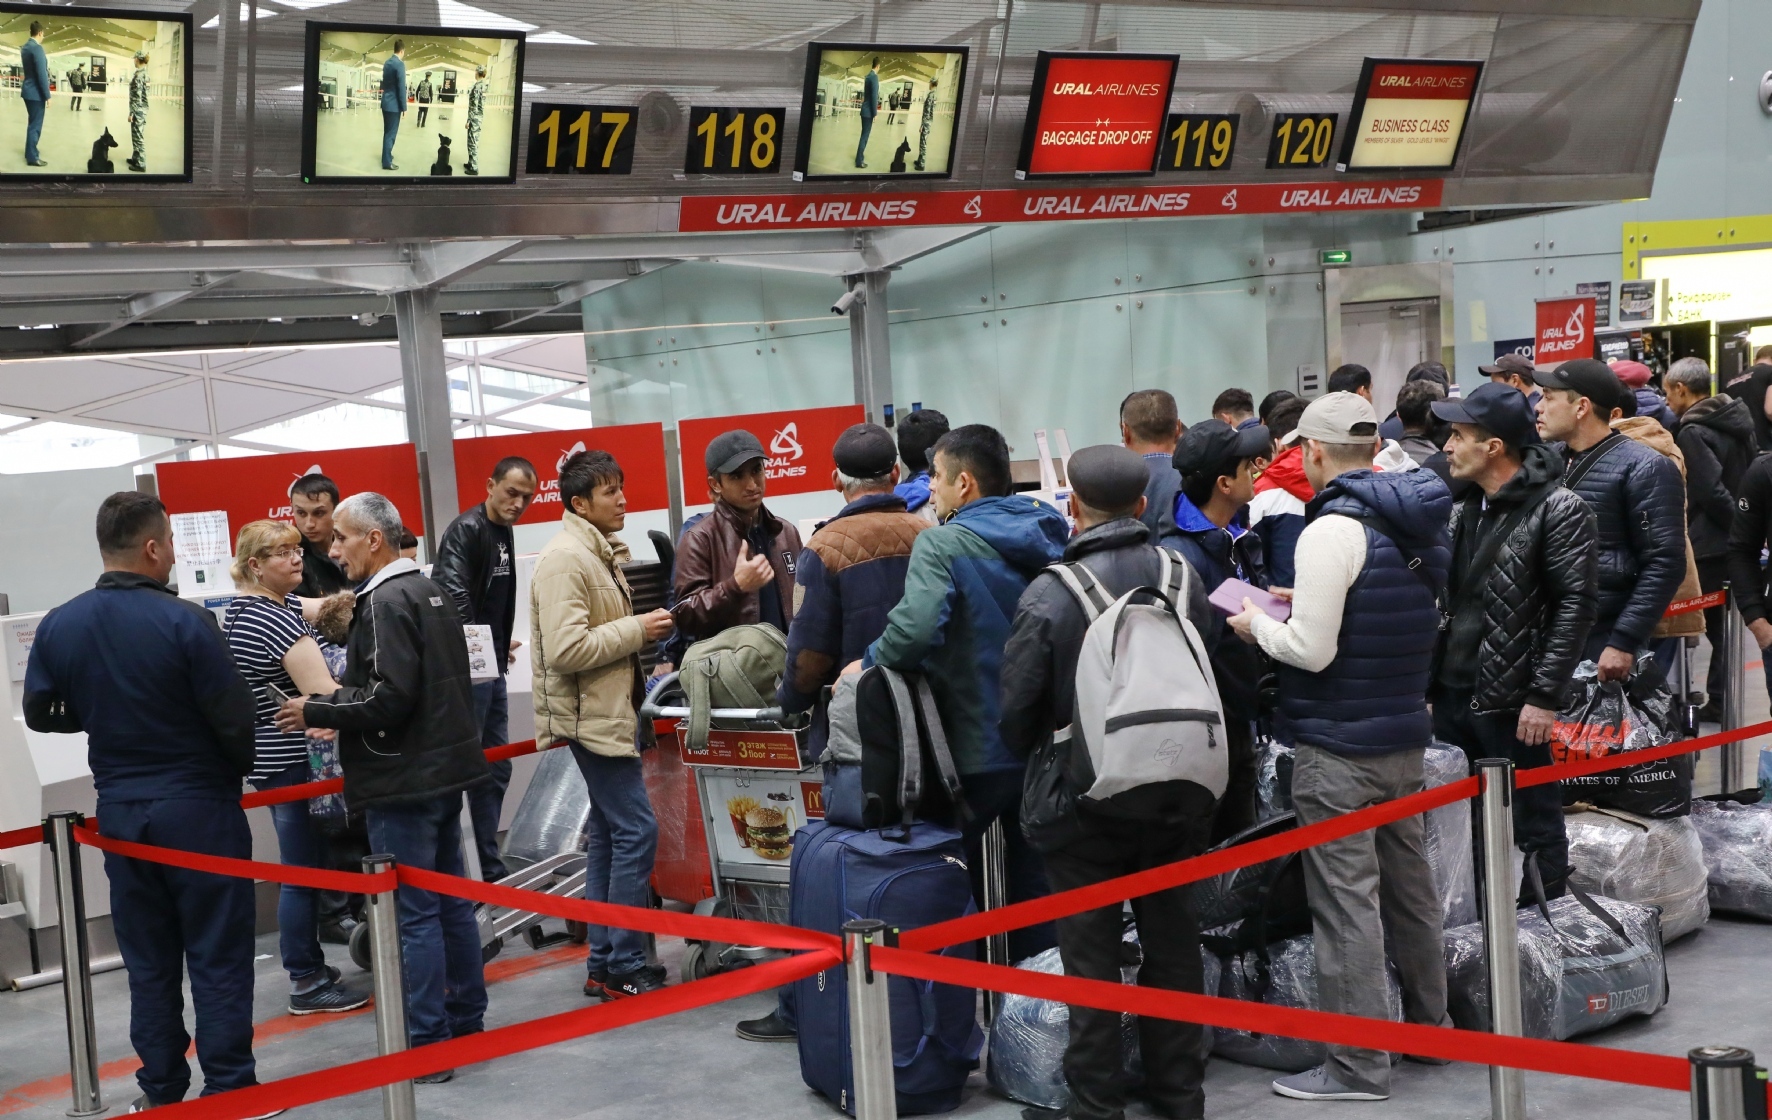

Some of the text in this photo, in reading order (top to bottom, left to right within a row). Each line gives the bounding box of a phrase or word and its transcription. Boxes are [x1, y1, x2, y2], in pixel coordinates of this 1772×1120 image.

[1053, 82, 1160, 97] URAL AIRLINES
[1380, 75, 1467, 88] URAL AIRLINES
[1371, 119, 1450, 133] BUSINESS CLASS
[538, 109, 630, 168] 117
[697, 112, 777, 168] 118
[1041, 129, 1152, 147] BAGGAGE DROP OFF
[1170, 119, 1232, 168] 119
[1276, 117, 1332, 165] 120
[1023, 192, 1190, 215] URAL AIRLINES
[1279, 186, 1422, 208] URAL AIRLINES
[716, 199, 918, 225] URAL AIRLINES
[1542, 327, 1564, 339] URAL
[1539, 339, 1577, 353] AIRLINES
[765, 466, 807, 479] RLINES
[540, 480, 560, 491] UR
[532, 491, 562, 504] AIRL
[268, 506, 294, 519] UR
[1670, 602, 1688, 611] URAL
[1689, 593, 1719, 606] AIRLINES
[737, 741, 748, 759] 3
[747, 742, 766, 750] этаж
[748, 751, 766, 759] floor
[1560, 770, 1677, 786] STATES OF AMERICA
[1608, 984, 1650, 1012] DIESEL
